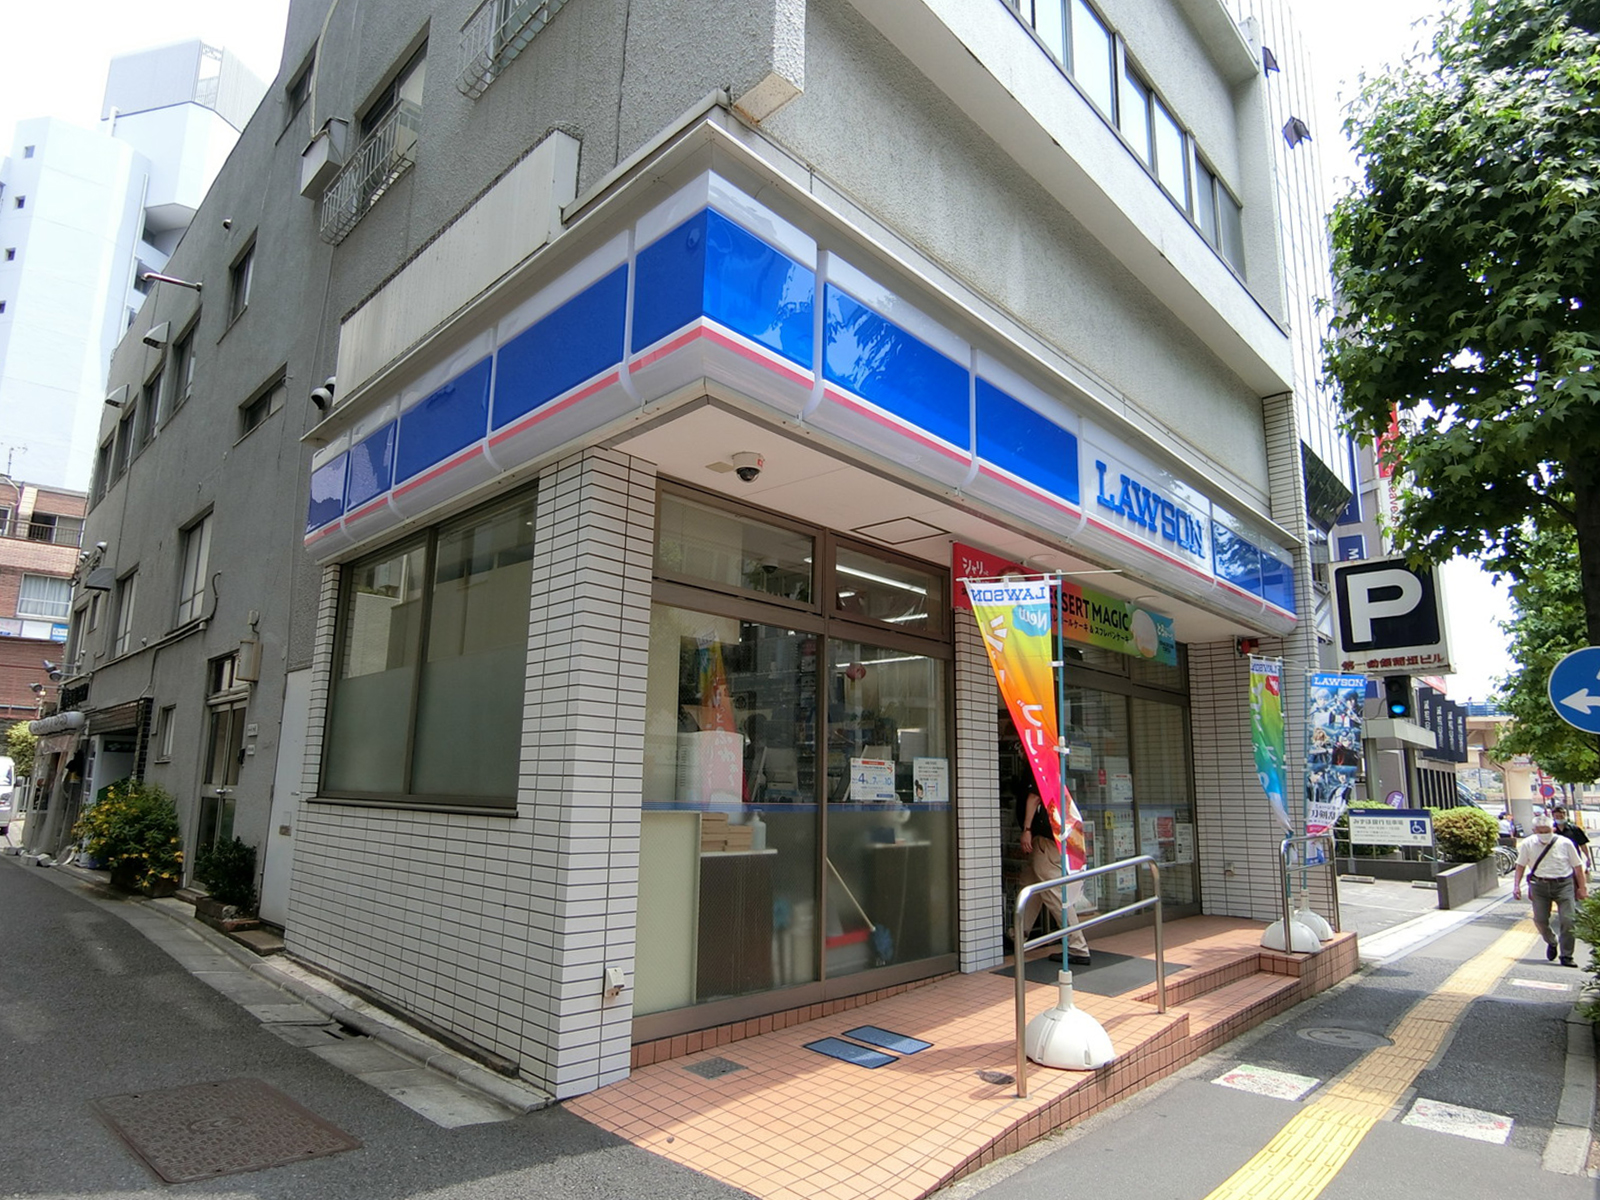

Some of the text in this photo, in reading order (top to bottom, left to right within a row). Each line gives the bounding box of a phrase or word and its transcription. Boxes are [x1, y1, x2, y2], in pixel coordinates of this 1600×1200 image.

[1095, 459, 1206, 559] LAWSON
[1091, 602, 1129, 632] MAGIC
[1346, 568, 1423, 644] P
[1313, 676, 1364, 688] LAWSON
